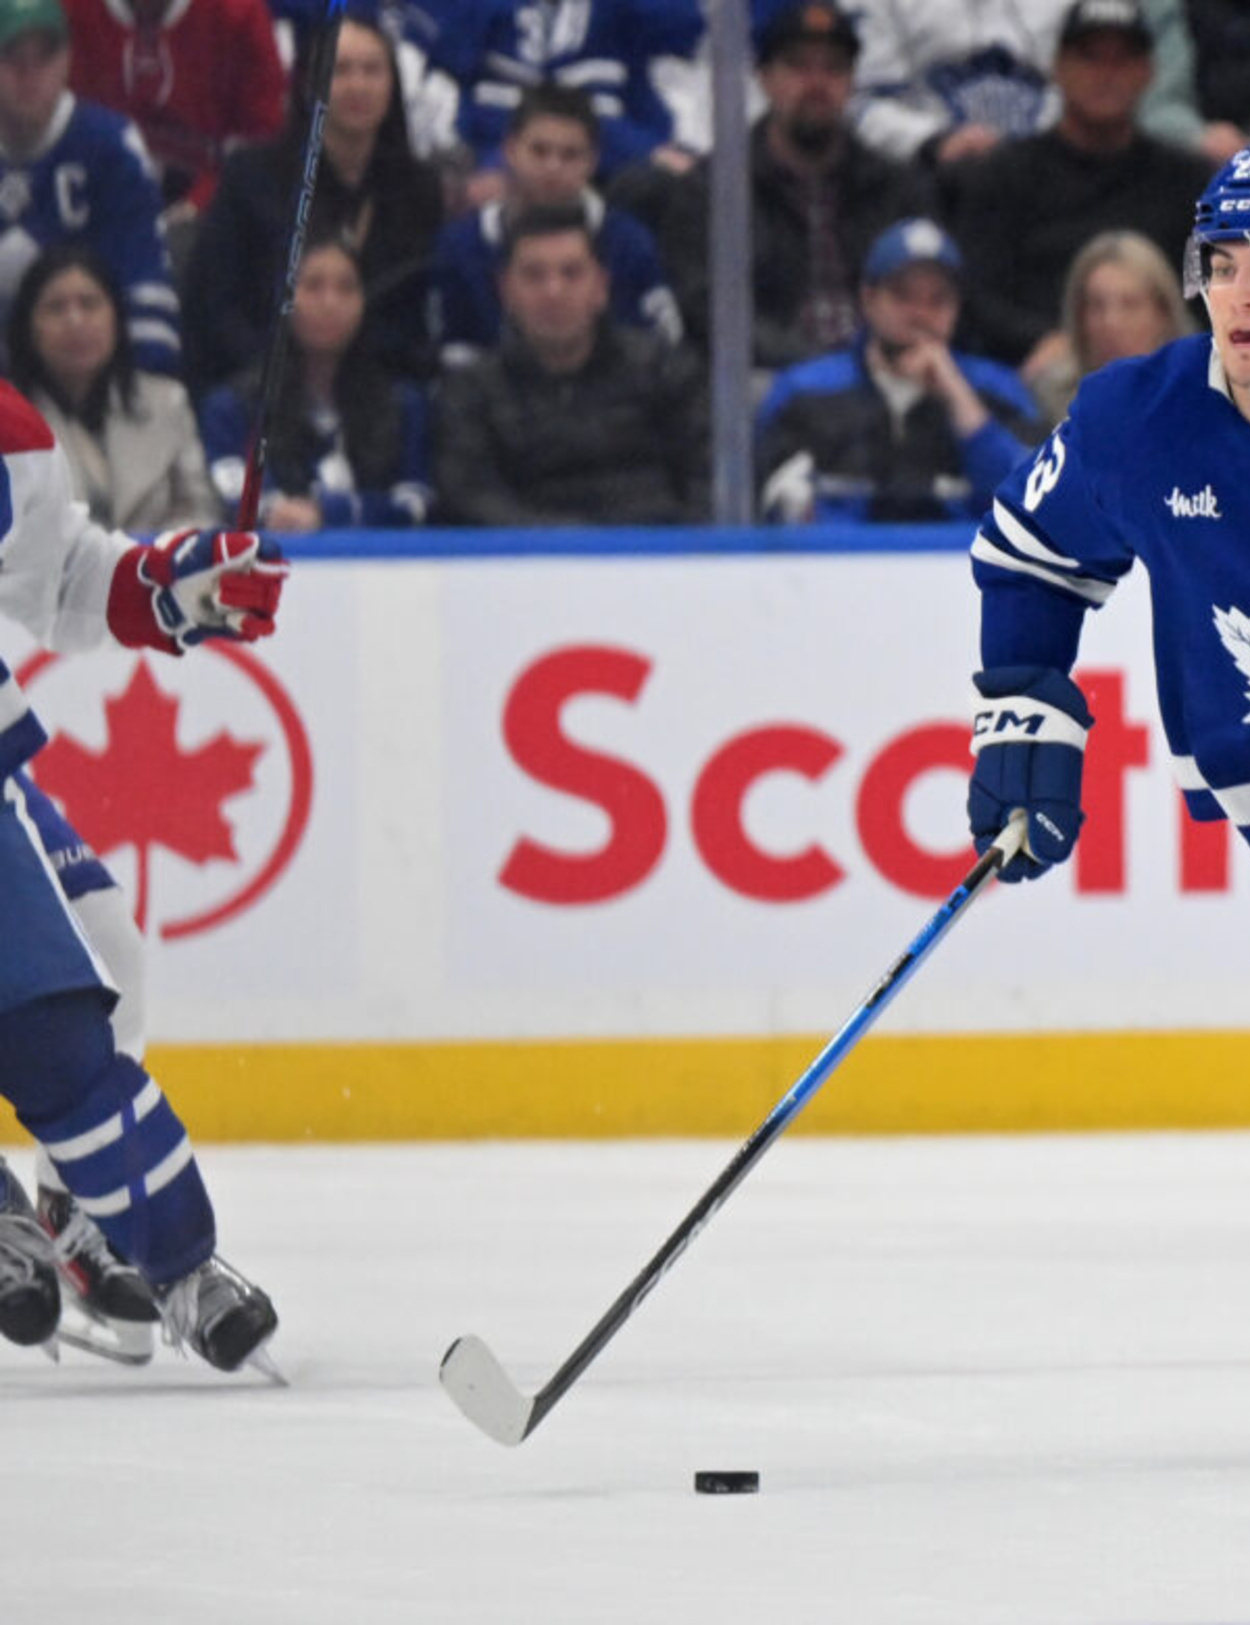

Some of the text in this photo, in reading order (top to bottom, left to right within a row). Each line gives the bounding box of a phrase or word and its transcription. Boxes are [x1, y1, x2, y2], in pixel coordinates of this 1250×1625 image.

[55, 162, 90, 230] C
[1164, 484, 1223, 519] milk
[973, 709, 1047, 737] CM
